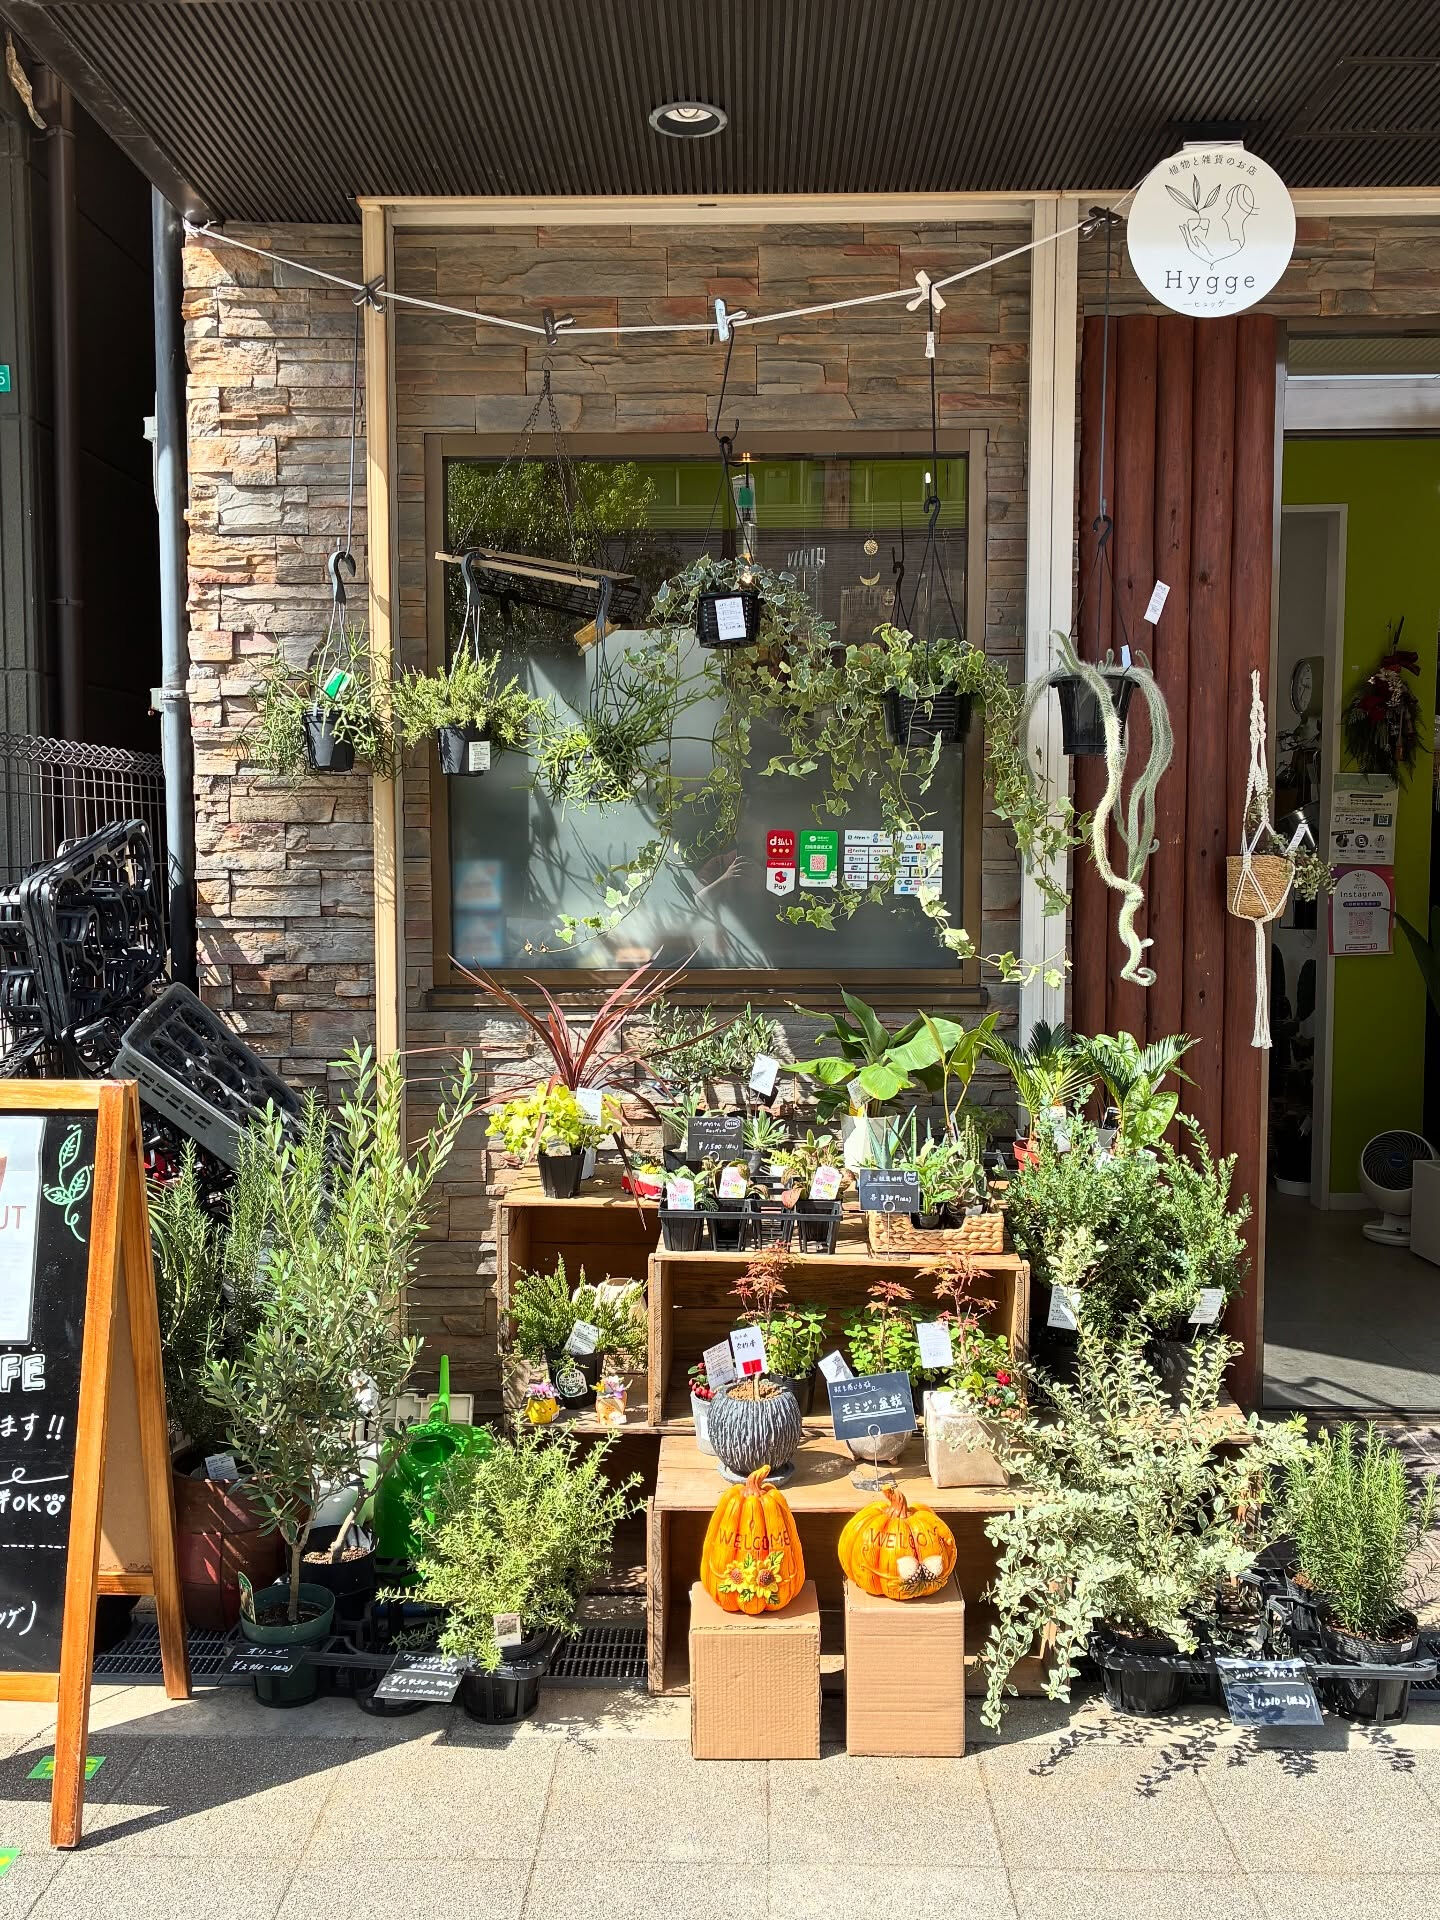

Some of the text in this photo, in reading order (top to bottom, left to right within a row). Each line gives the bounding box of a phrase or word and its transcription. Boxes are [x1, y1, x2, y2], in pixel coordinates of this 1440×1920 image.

[1168, 154, 1258, 176] 植物と雑貨のお店
[1164, 270, 1256, 295] Hygge
[769, 835, 793, 846] d払い
[774, 883, 787, 892] Pay
[1340, 890, 1384, 898] Instagram
[0, 1353, 46, 1393] FE
[842, 1393, 903, 1415] モミジの盆栽
[719, 1528, 791, 1550] WELCOME
[247, 1647, 289, 1655] オリーブ
